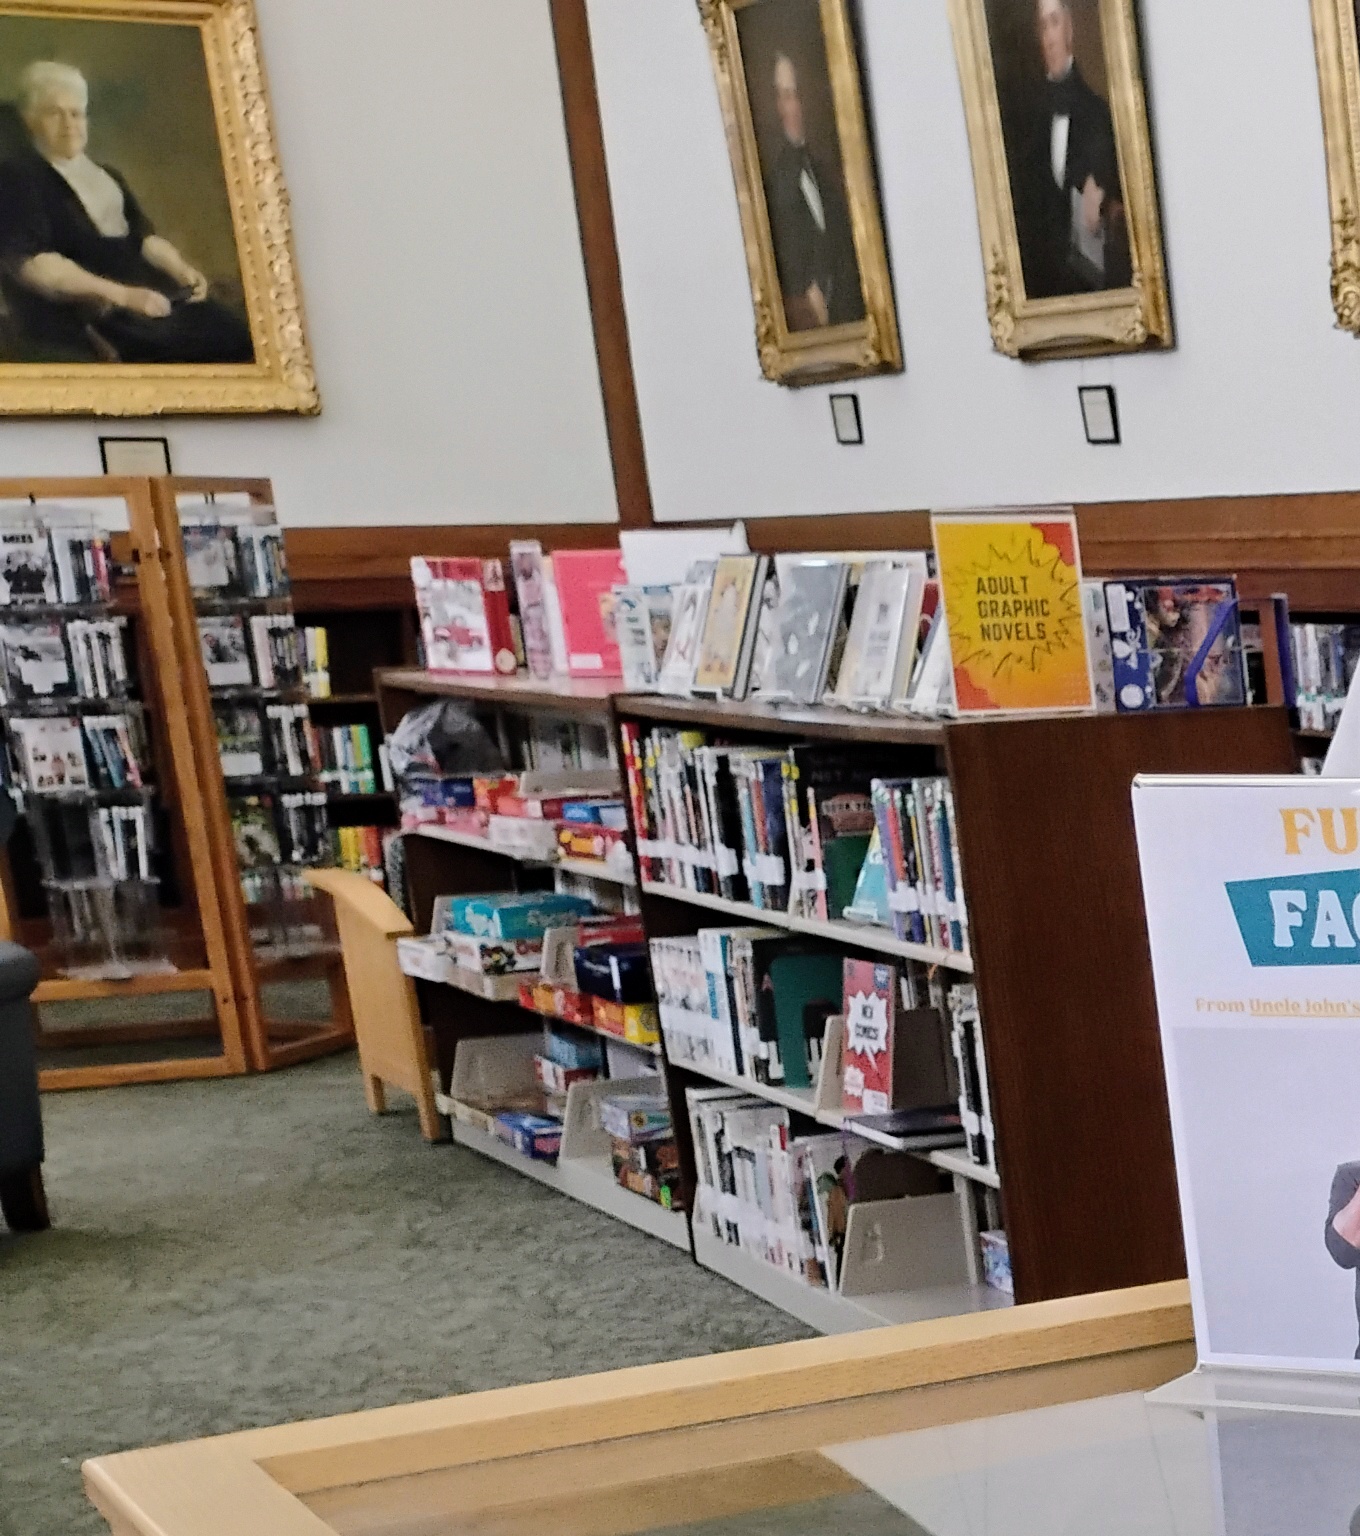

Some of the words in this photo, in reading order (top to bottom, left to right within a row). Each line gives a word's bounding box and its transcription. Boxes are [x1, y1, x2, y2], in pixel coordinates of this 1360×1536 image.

[977, 576, 1029, 595] ADULT
[977, 600, 1050, 619] GRAPHIC
[980, 622, 1046, 641] NOVELS
[1195, 998, 1245, 1013] From
[1249, 998, 1301, 1015] Uncle
